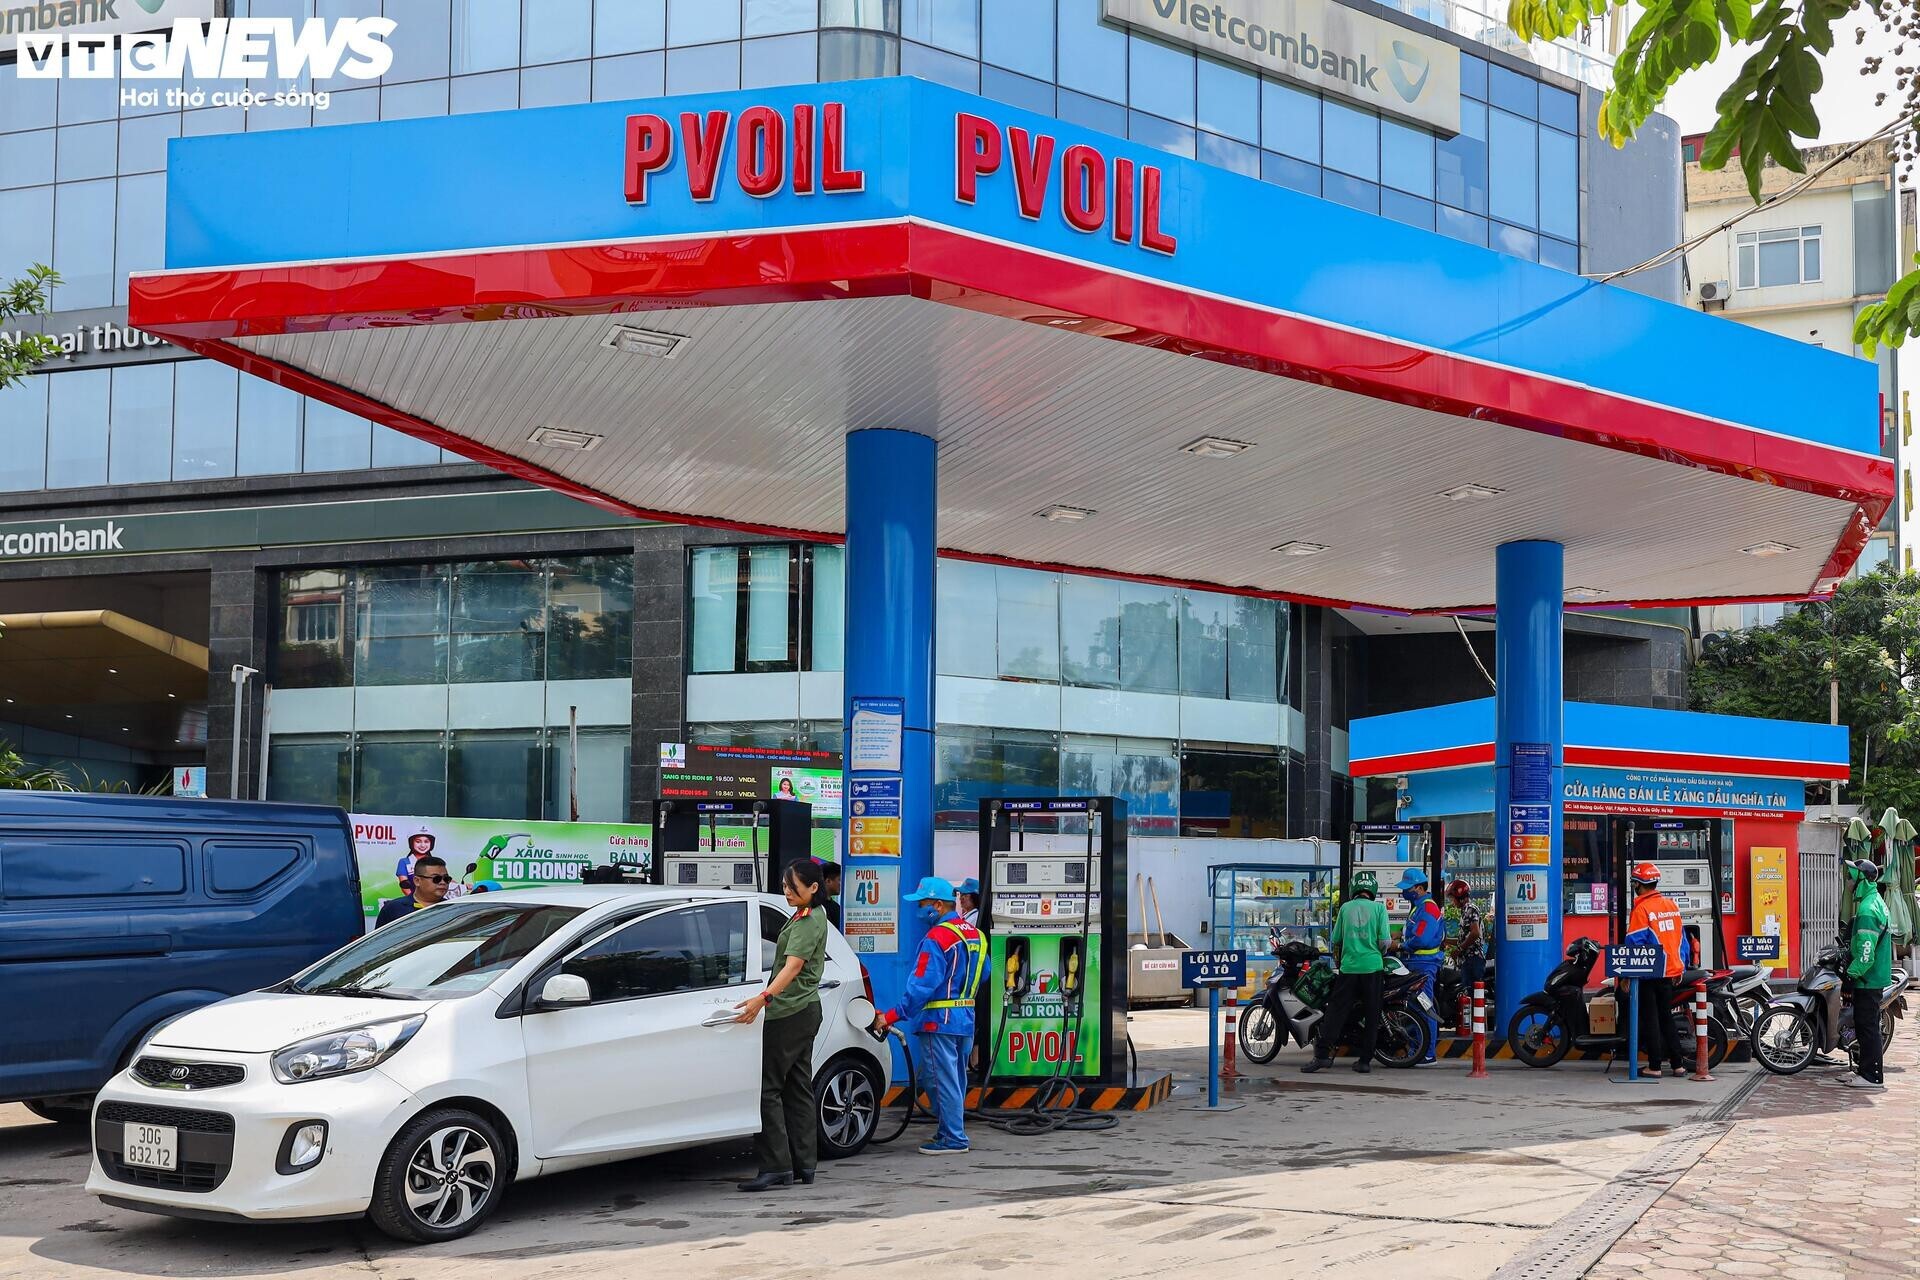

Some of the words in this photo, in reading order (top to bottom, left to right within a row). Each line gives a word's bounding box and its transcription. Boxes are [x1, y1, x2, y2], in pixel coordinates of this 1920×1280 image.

[624, 102, 865, 205] PVOIL
[955, 112, 1177, 256] PVOIL
[1564, 780, 1589, 797] CỬA
[1592, 783, 1625, 799] HÀNG
[1629, 785, 1653, 801] BÁN
[1656, 785, 1670, 801] LẺ
[1674, 788, 1704, 803] XĂNG
[1707, 787, 1730, 804] DẦU
[1732, 791, 1764, 806] NGHĨA
[1766, 792, 1786, 807] TÂN
[355, 825, 396, 840] PVOIL
[609, 835, 622, 845] Cửa
[628, 836, 648, 848] hàng
[726, 836, 745, 847] điểm
[515, 846, 553, 859] XĂNG
[610, 849, 637, 864] BÁN
[493, 860, 525, 879] E10
[855, 870, 879, 880] PVOIL
[1516, 874, 1535, 882] PVOIL
[1612, 946, 1630, 956] LỐI
[1633, 945, 1656, 956] VÀO
[1860, 940, 1872, 963] Grab
[1189, 952, 1209, 964] LỐI
[1213, 952, 1238, 963] VÀO
[1612, 958, 1627, 966] XE
[1630, 956, 1656, 966] MÁY
[1200, 964, 1208, 975] Ô
[1213, 964, 1229, 974] TÔ
[171, 1067, 186, 1077] KIA
[139, 1126, 161, 1146] 30G
[129, 1147, 170, 1167] 832.12
